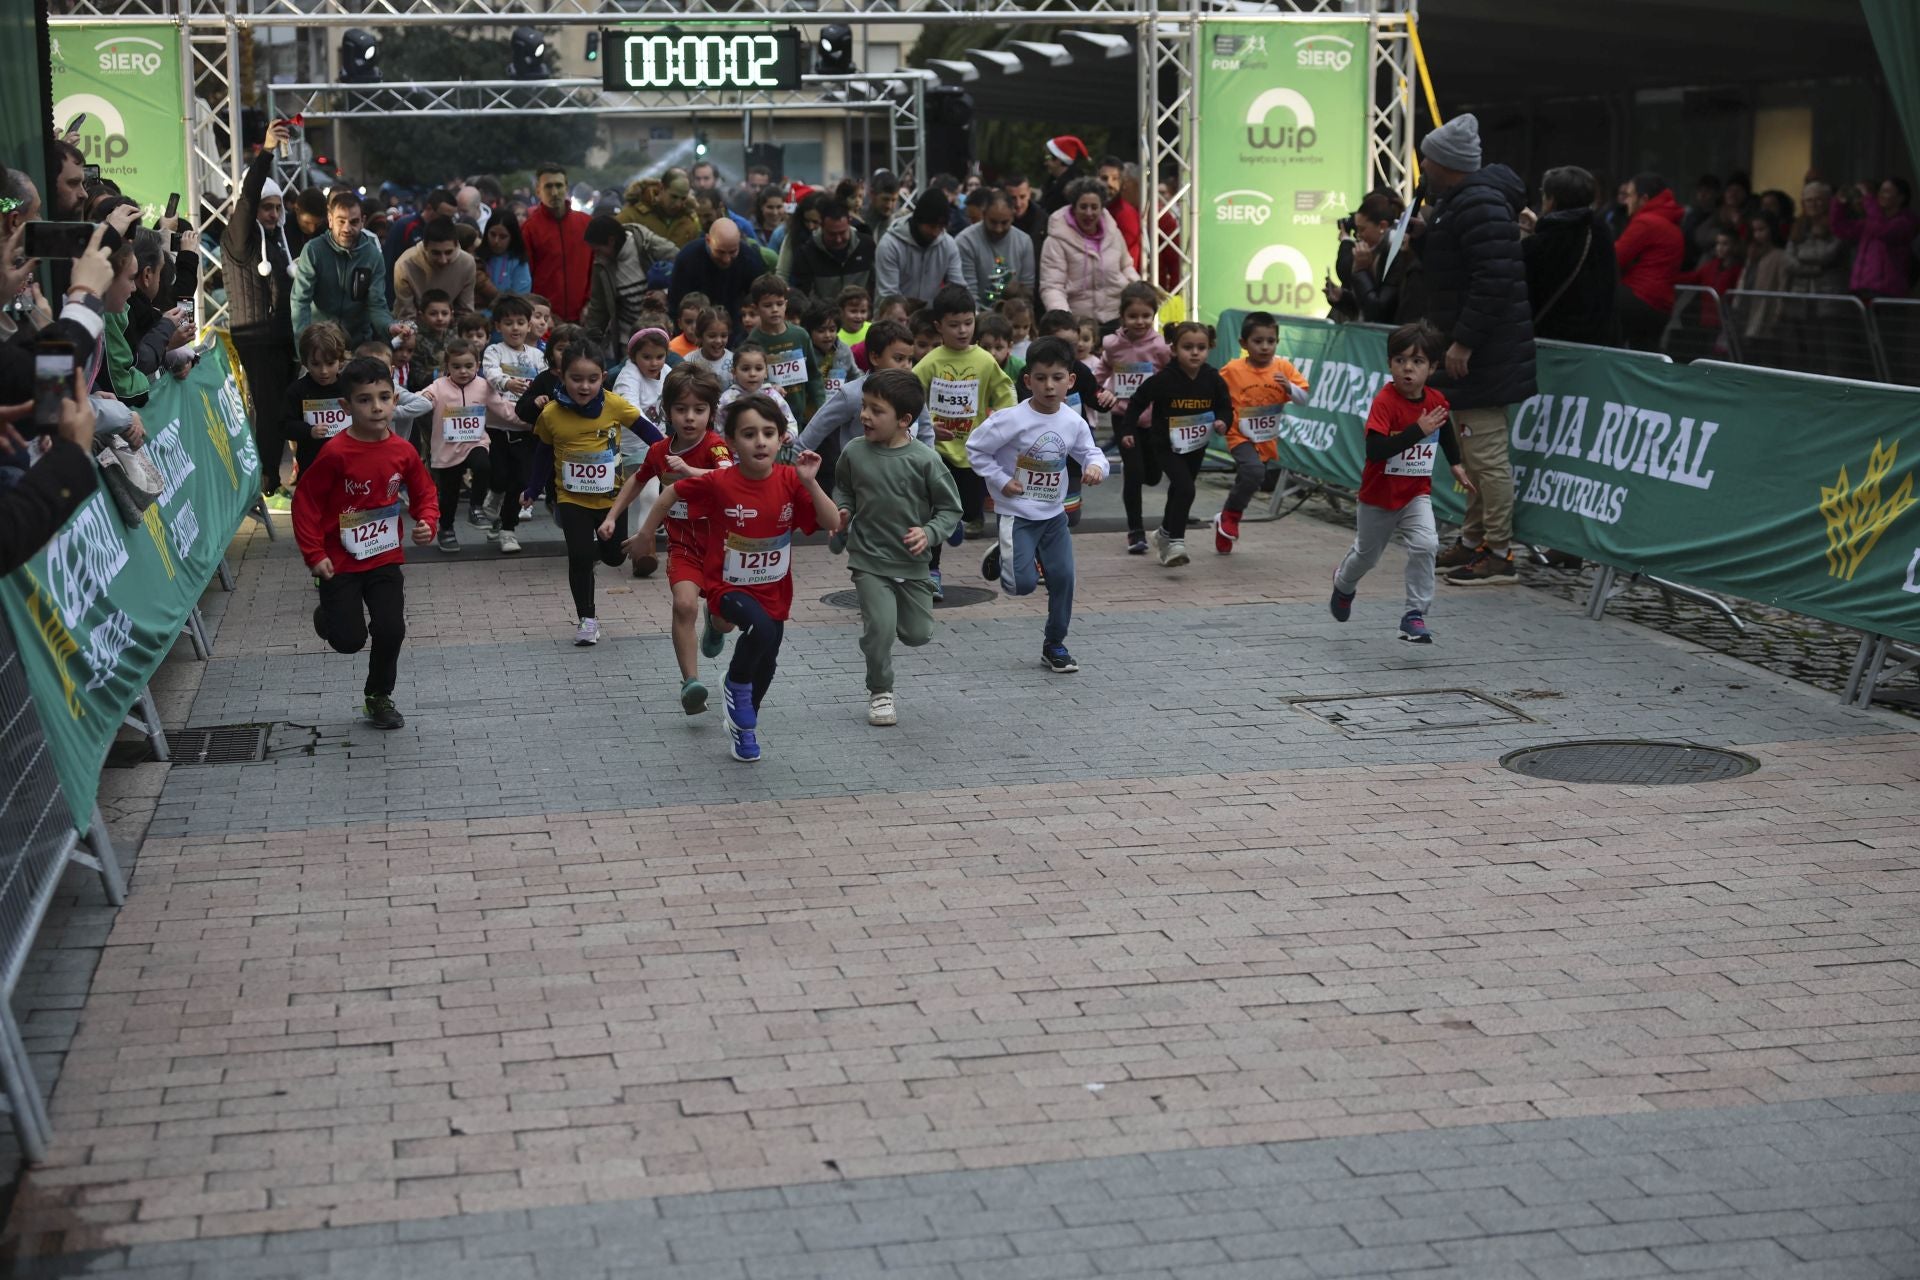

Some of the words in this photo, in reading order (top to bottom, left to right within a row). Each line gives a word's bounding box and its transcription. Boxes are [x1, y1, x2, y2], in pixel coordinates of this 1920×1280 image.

[98, 47, 161, 76] SIERO
[624, 35, 779, 87] 00:00:02
[1296, 43, 1352, 72] SIERO
[1215, 198, 1271, 225] SIERO
[771, 361, 800, 376] 1276
[824, 379, 841, 391] 89
[1117, 374, 1144, 385] 1147
[1308, 360, 1394, 420] RURA
[312, 410, 346, 424] 1180
[451, 417, 480, 430] 1168
[1247, 416, 1276, 430] 1165
[1179, 425, 1207, 441] 1159
[1279, 414, 1337, 451] STURIAS
[1511, 394, 1590, 459] CAJA
[1586, 400, 1720, 490] RURAL
[1401, 444, 1433, 460] 1214
[569, 463, 607, 479] 1209
[1026, 470, 1061, 487] 1213
[1508, 464, 1528, 501] E
[1522, 468, 1629, 525] ASTURIAS
[351, 519, 389, 544] 1224
[364, 539, 379, 548] LUCA
[739, 550, 782, 569] 1219
